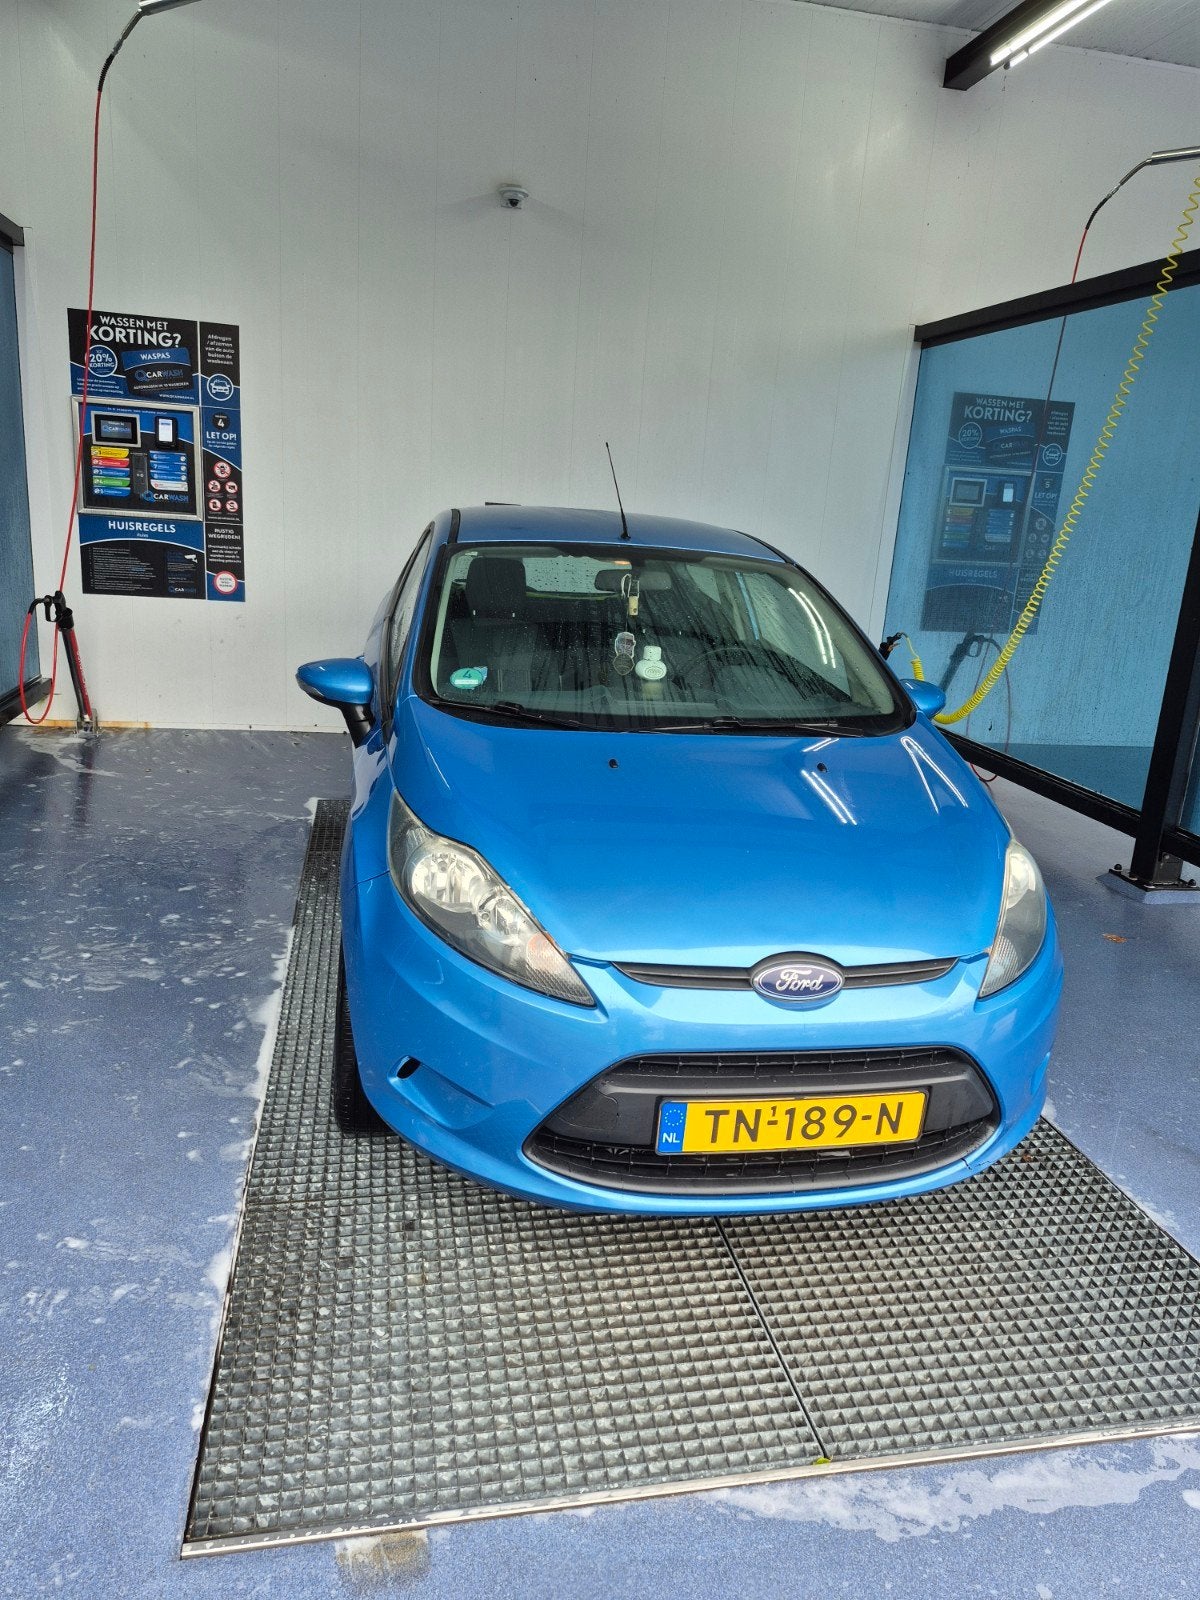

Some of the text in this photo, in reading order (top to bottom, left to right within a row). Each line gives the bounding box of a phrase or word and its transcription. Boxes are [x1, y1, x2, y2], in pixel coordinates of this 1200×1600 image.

[100, 316, 168, 330] WASSEN MET
[87, 324, 182, 348] KORTING?
[90, 354, 112, 362] 20%
[140, 352, 171, 360] WASPAS
[976, 398, 1025, 409] WASSEN MET
[964, 405, 1032, 423] KORTING?
[217, 418, 225, 428] 4
[206, 431, 237, 441] LET OP!
[108, 520, 176, 533] HUISREGELS
[776, 969, 824, 991] Ford
[705, 1102, 903, 1143] TN-189-N
[662, 1132, 680, 1143] NL
